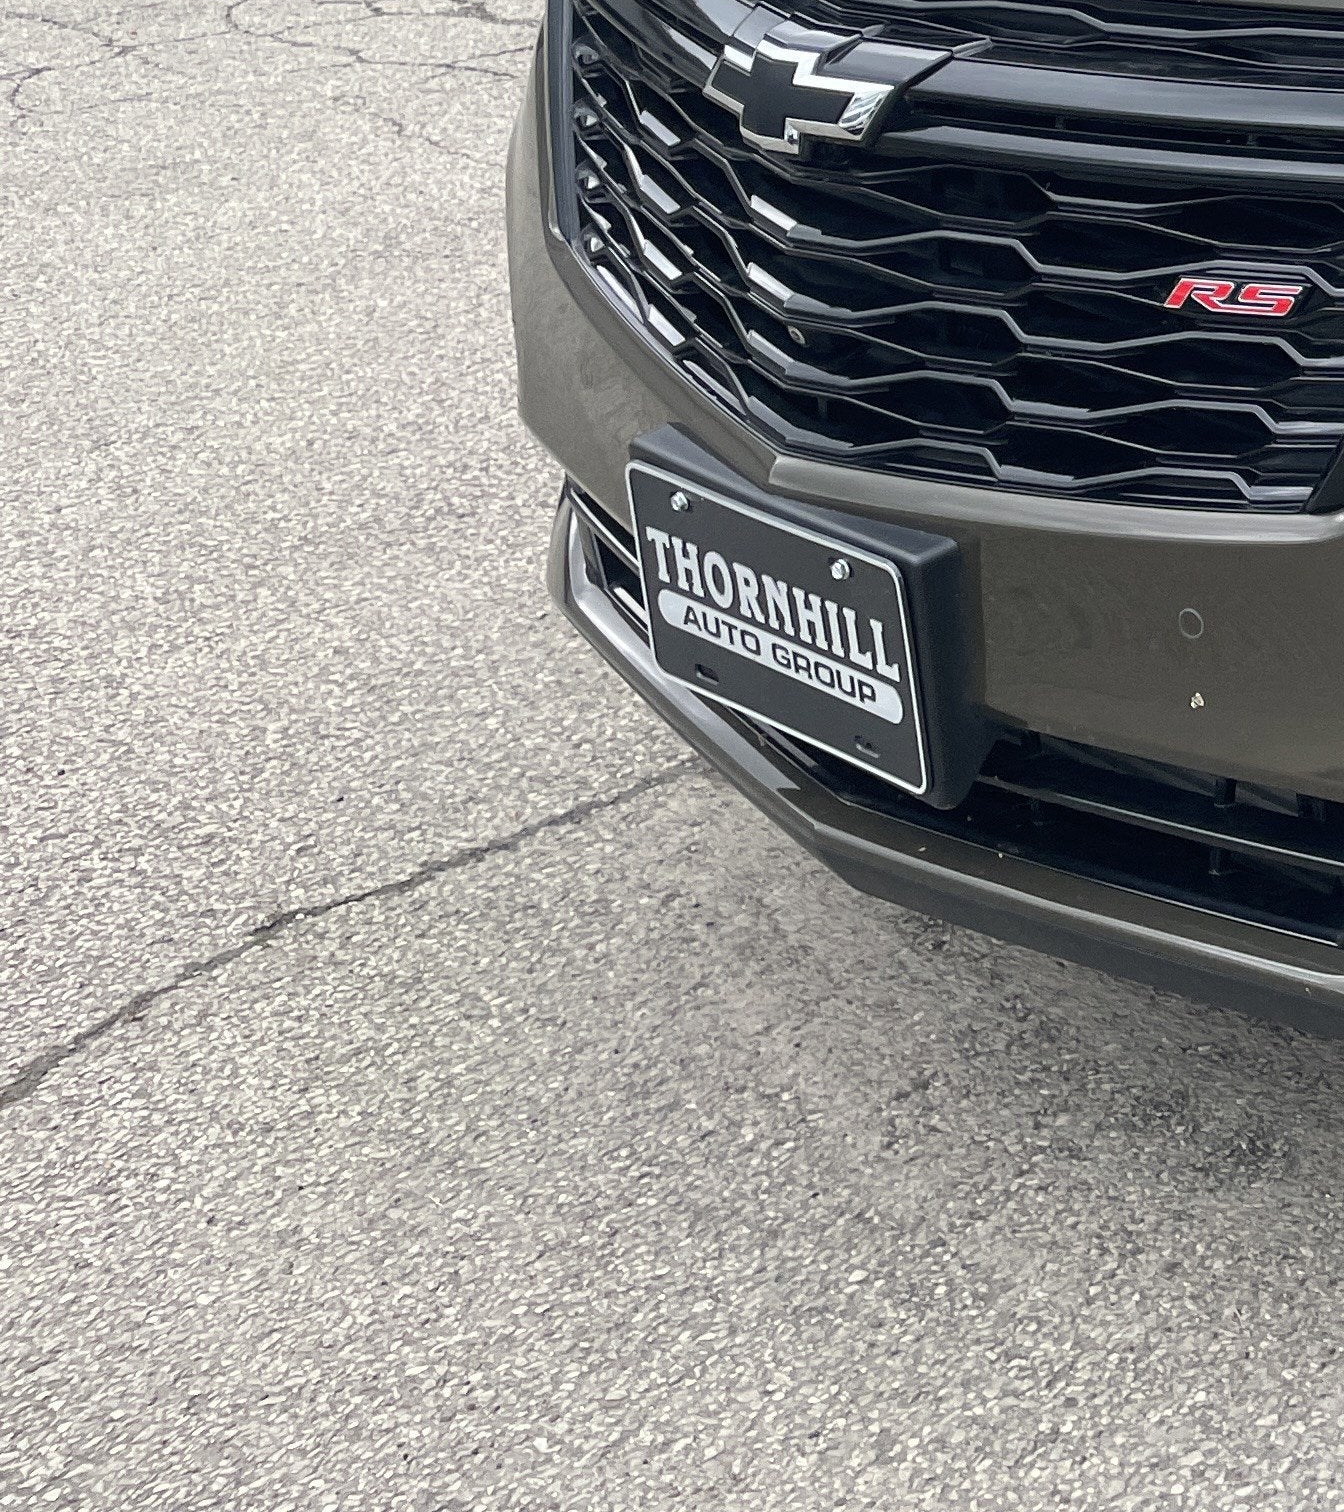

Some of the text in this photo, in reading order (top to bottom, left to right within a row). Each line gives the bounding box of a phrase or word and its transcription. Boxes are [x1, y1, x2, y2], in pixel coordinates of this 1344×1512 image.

[1164, 278, 1303, 317] RS
[646, 526, 901, 683] THORNHILL
[683, 604, 878, 706] AUTO GROUP
